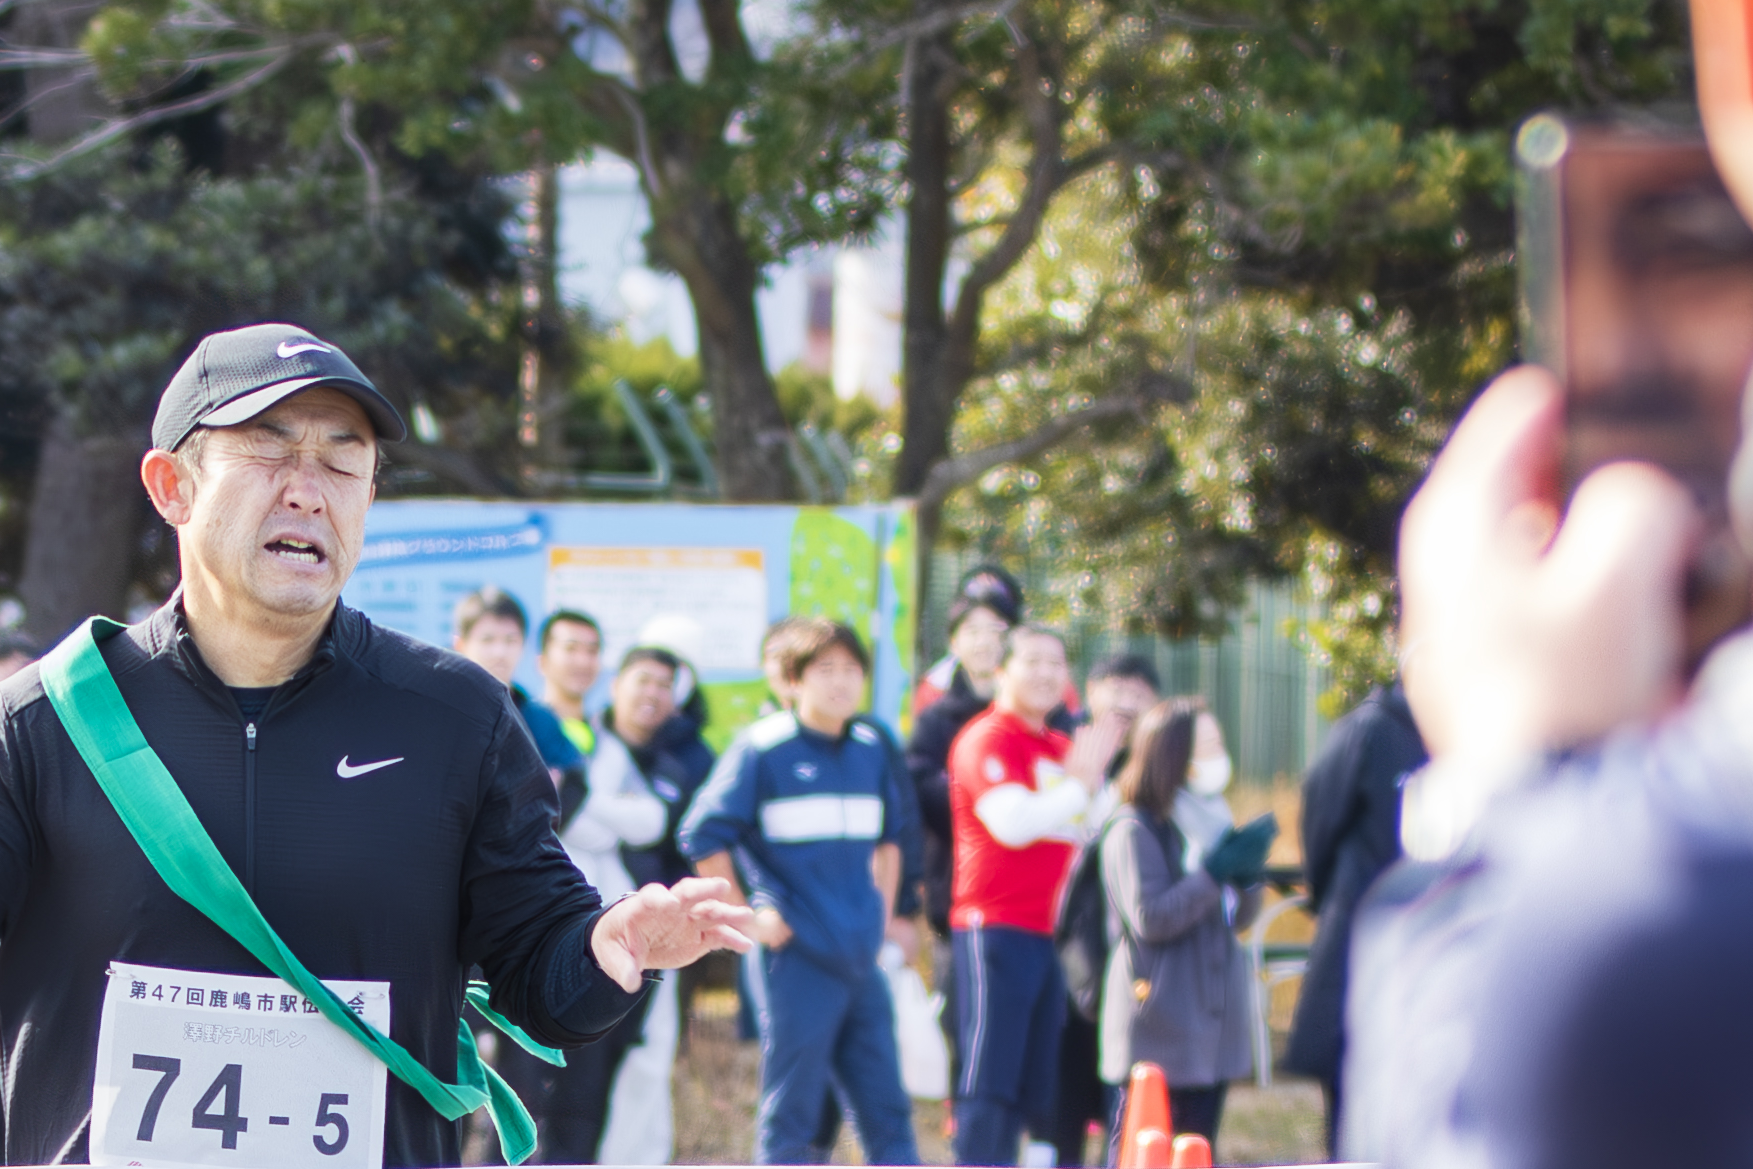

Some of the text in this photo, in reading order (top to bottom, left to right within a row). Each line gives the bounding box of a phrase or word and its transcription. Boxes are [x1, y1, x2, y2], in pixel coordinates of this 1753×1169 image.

[129, 980, 365, 1015] 第47回鹿嶋市駅伝会
